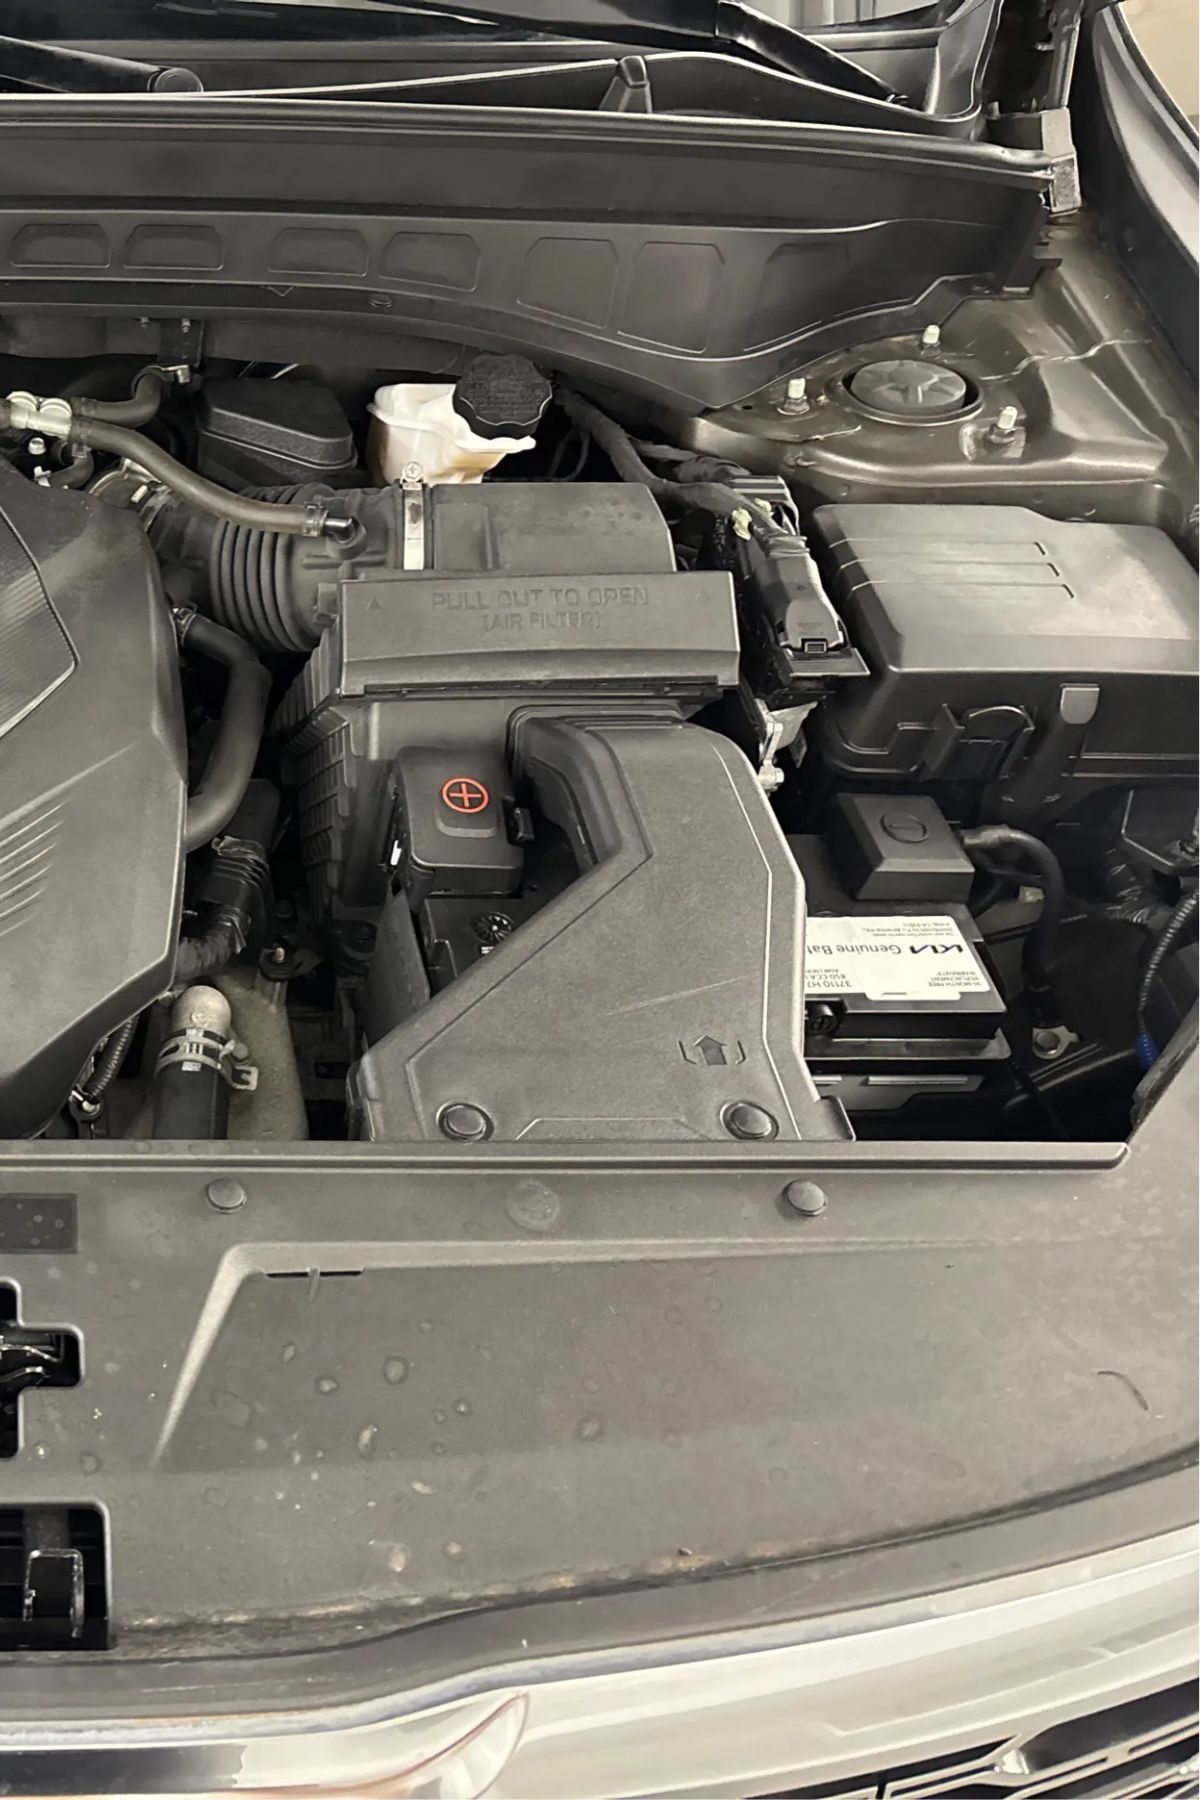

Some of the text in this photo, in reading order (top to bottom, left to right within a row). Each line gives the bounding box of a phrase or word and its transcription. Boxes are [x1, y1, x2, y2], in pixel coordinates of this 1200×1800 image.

[431, 586, 649, 610] PULL OUT TO OPEN
[806, 944, 963, 955] KIA Genuine Bat
